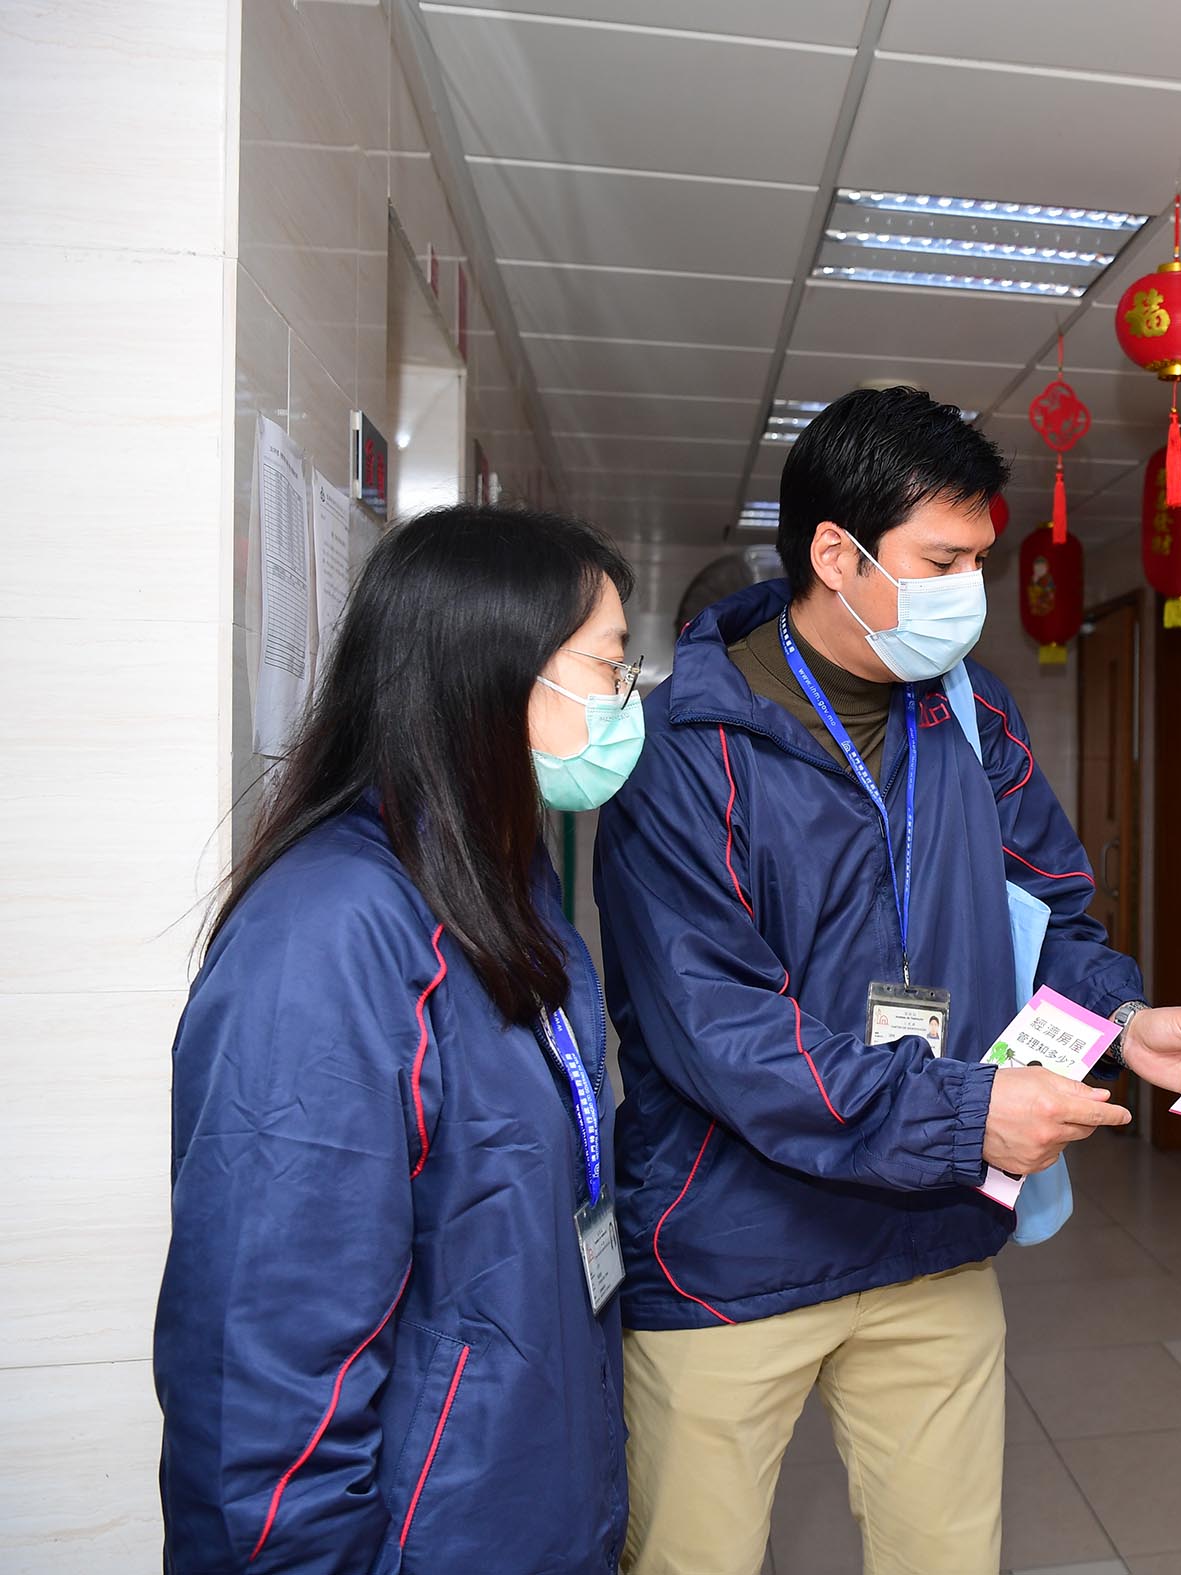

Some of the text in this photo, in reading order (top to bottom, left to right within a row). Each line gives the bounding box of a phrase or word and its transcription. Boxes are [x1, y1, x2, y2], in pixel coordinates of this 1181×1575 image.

[1125, 287, 1171, 338] 福
[798, 667, 837, 727] www.ihm.gov.mo
[1016, 1031, 1076, 1068] 管理知多少?
[1030, 1016, 1087, 1054] 經濟房屋
